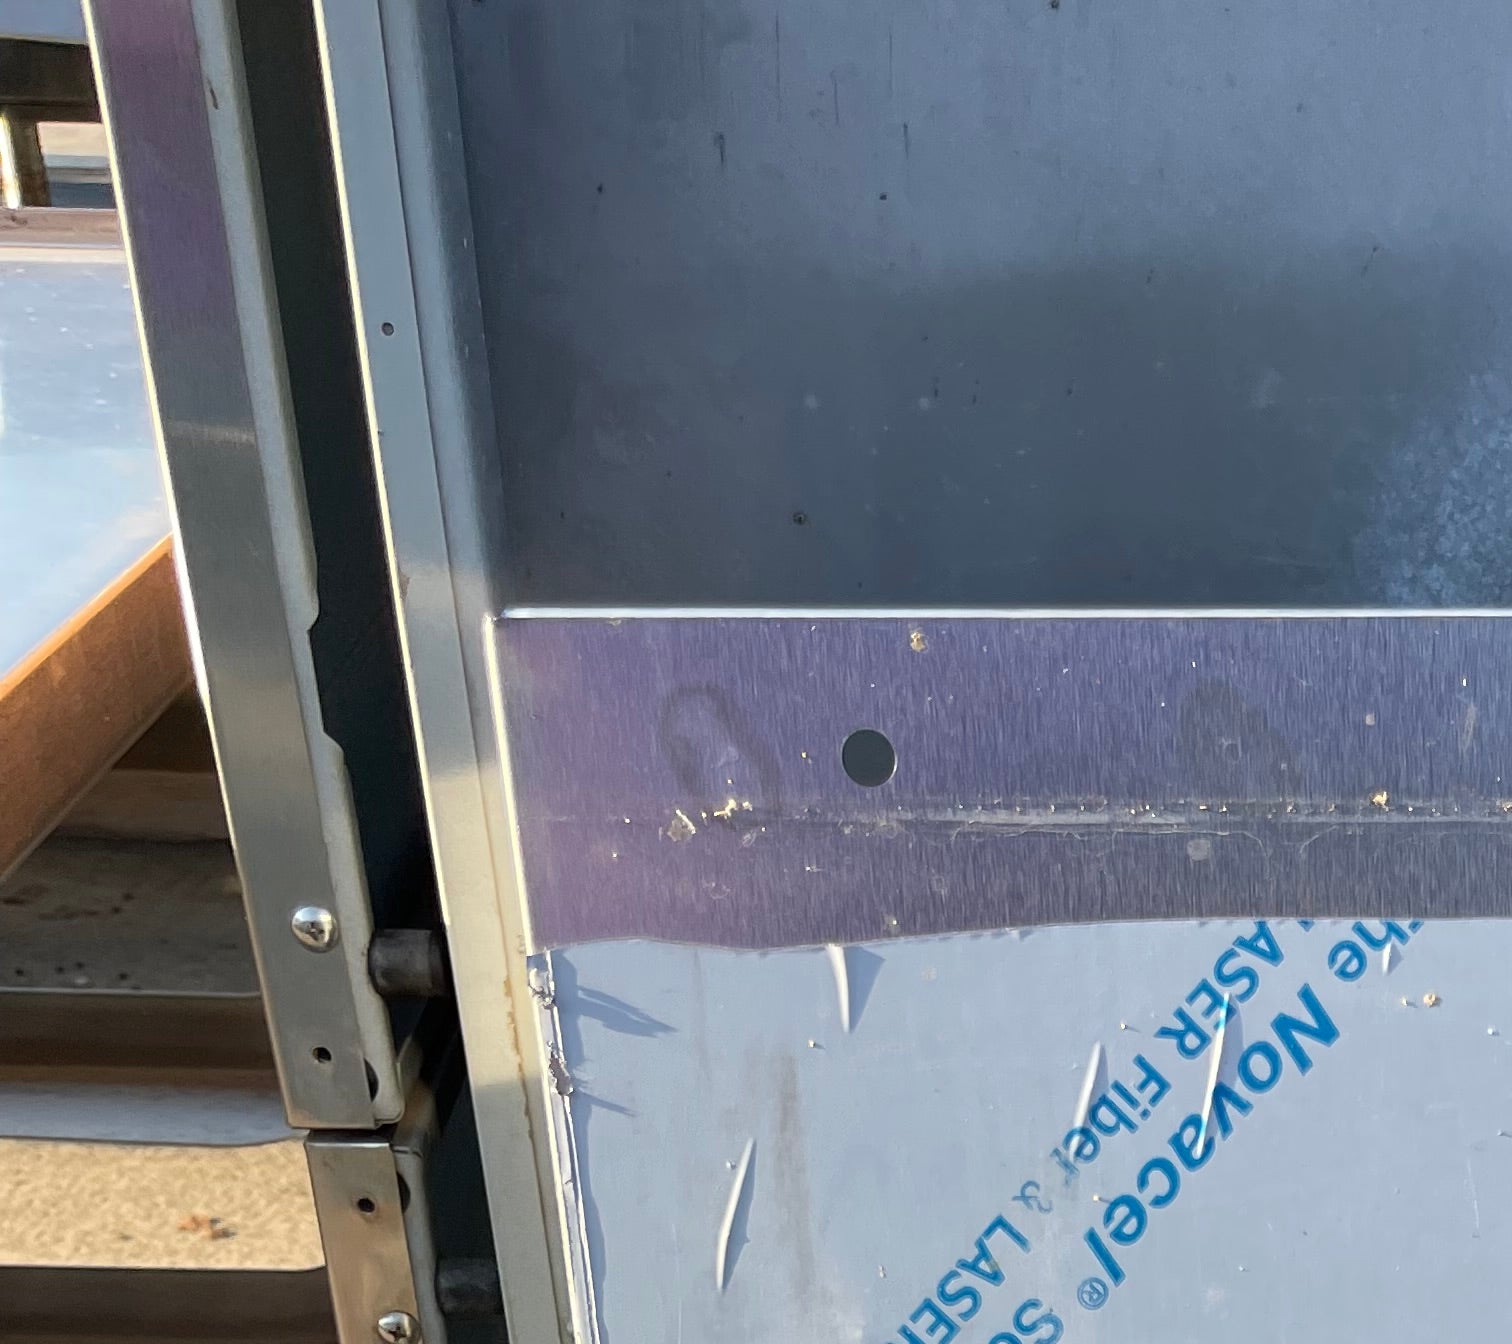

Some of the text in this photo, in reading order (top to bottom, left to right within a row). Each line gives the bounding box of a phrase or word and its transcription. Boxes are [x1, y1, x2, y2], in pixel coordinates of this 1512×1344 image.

[1154, 920, 1314, 1060] ASER
[1326, 920, 1424, 982] he
[1050, 1053, 1172, 1188] Fiber
[1011, 1179, 1053, 1215] &
